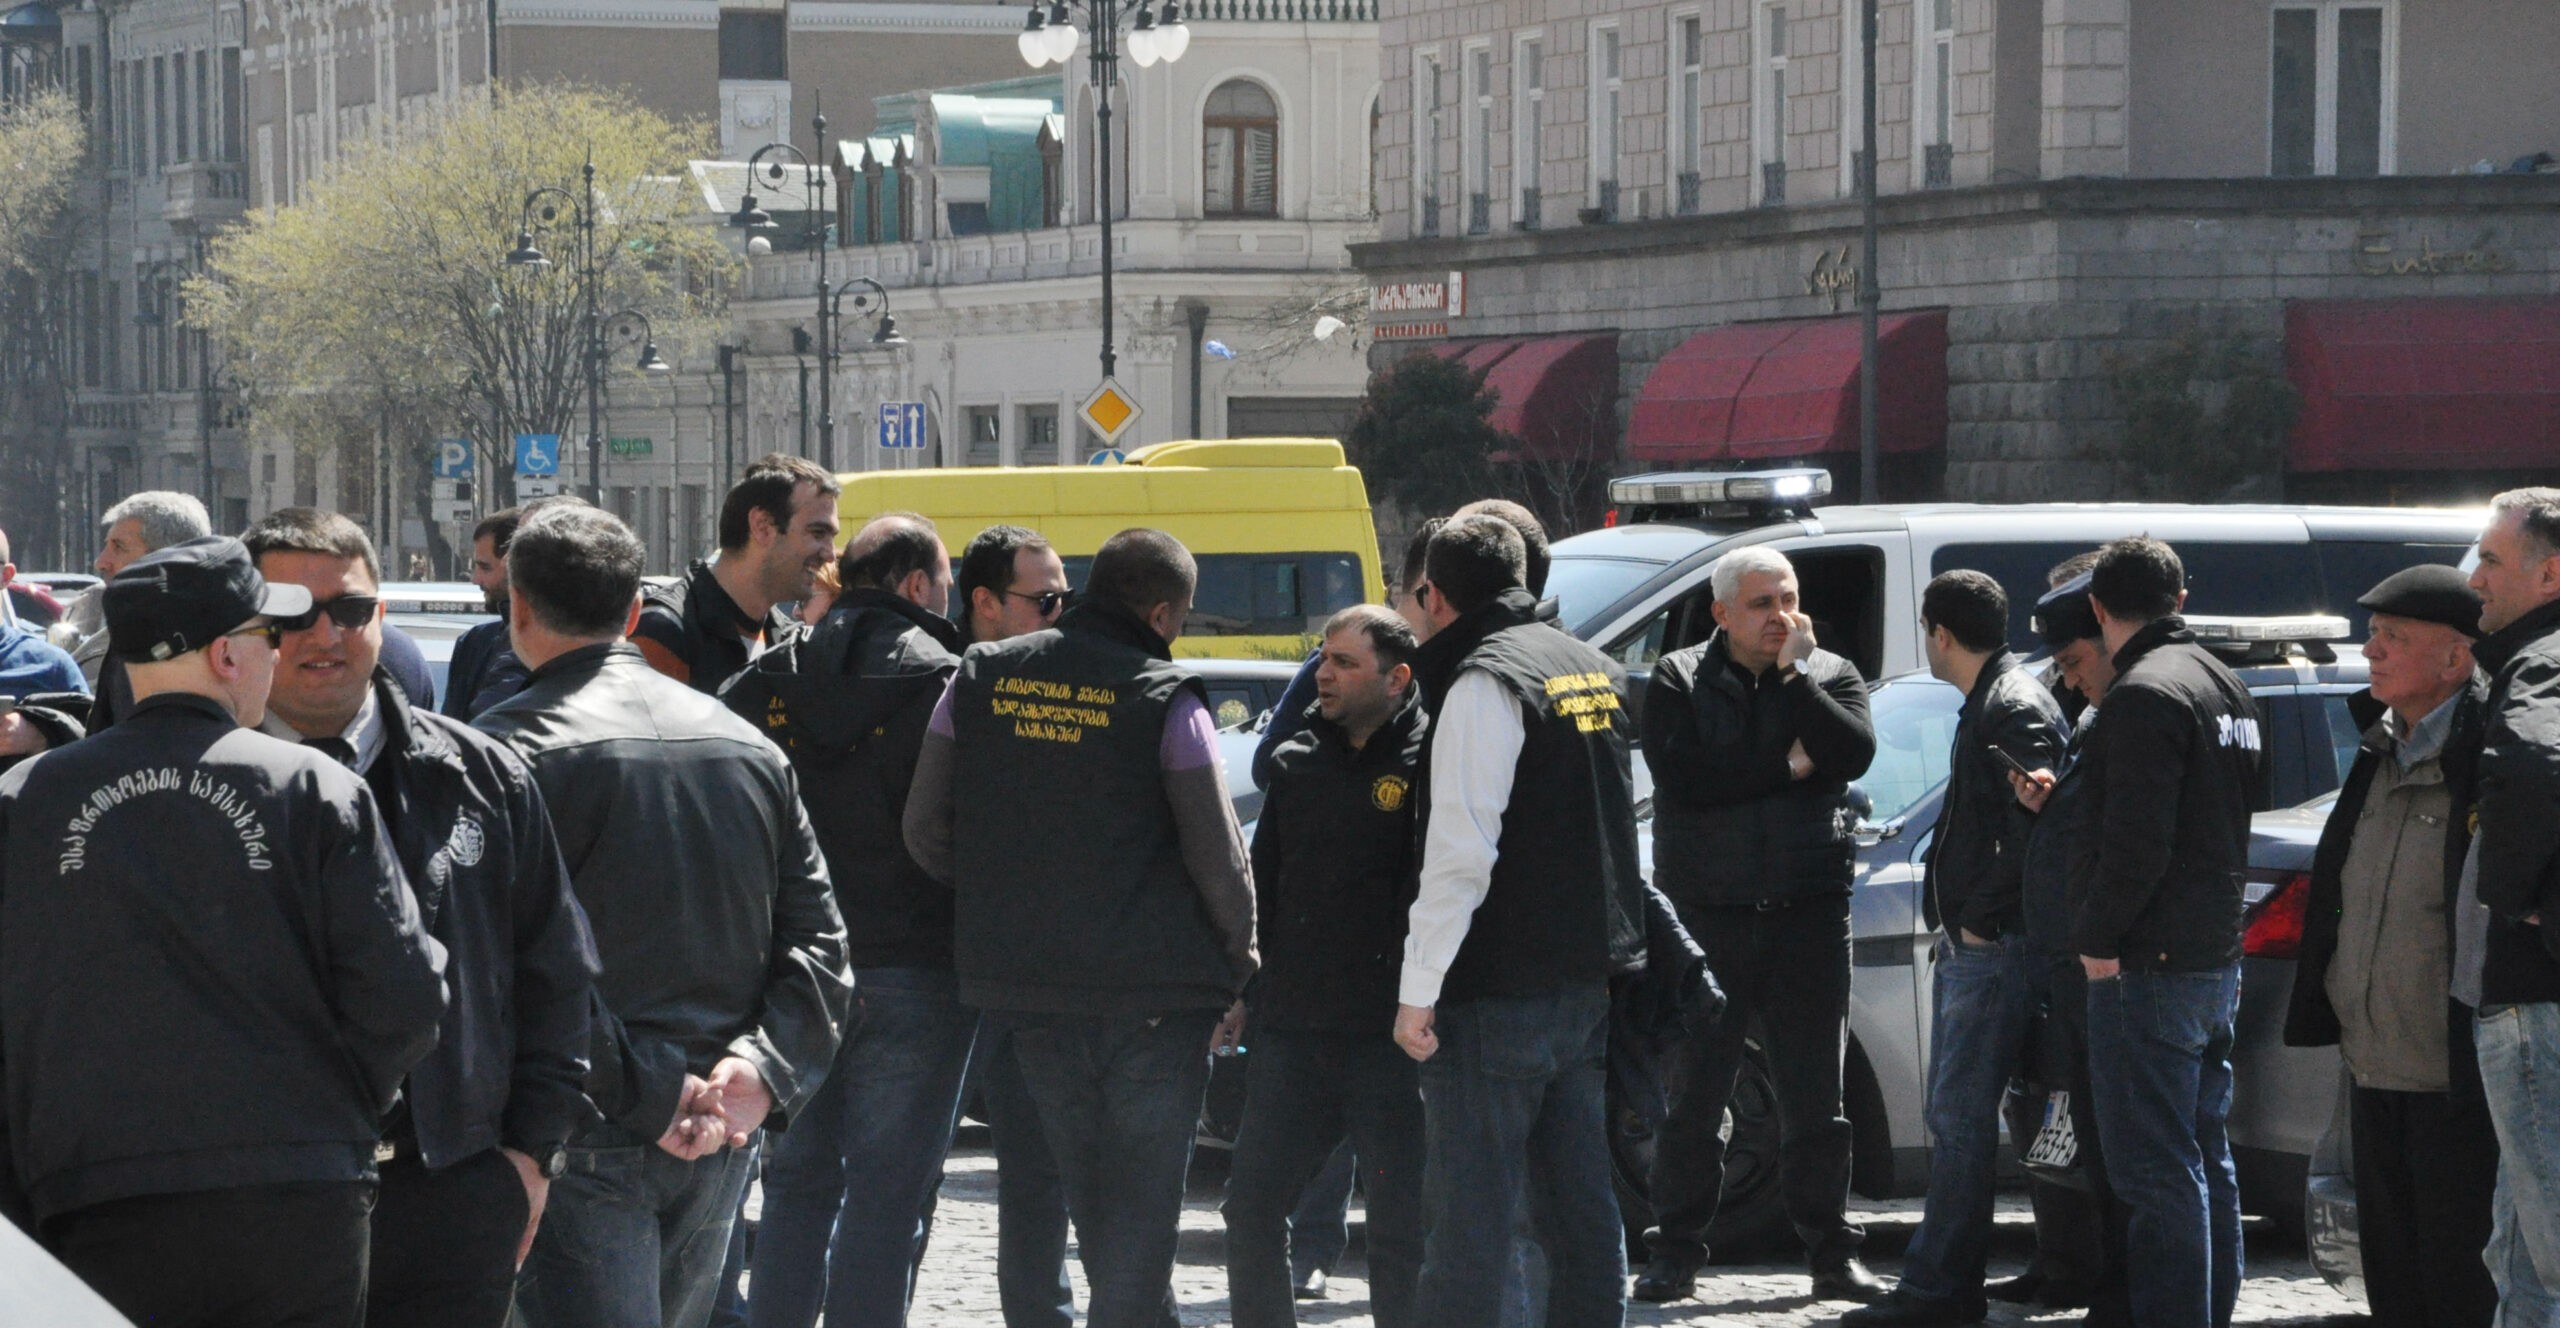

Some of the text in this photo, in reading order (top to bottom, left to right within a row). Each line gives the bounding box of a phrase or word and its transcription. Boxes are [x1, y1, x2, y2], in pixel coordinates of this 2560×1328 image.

[441, 442, 466, 476] P
[1077, 686, 1116, 705] მერია
[1014, 720, 1082, 743] სამსახური
[60, 767, 273, 876] უსაფრთხოების სამსახური
